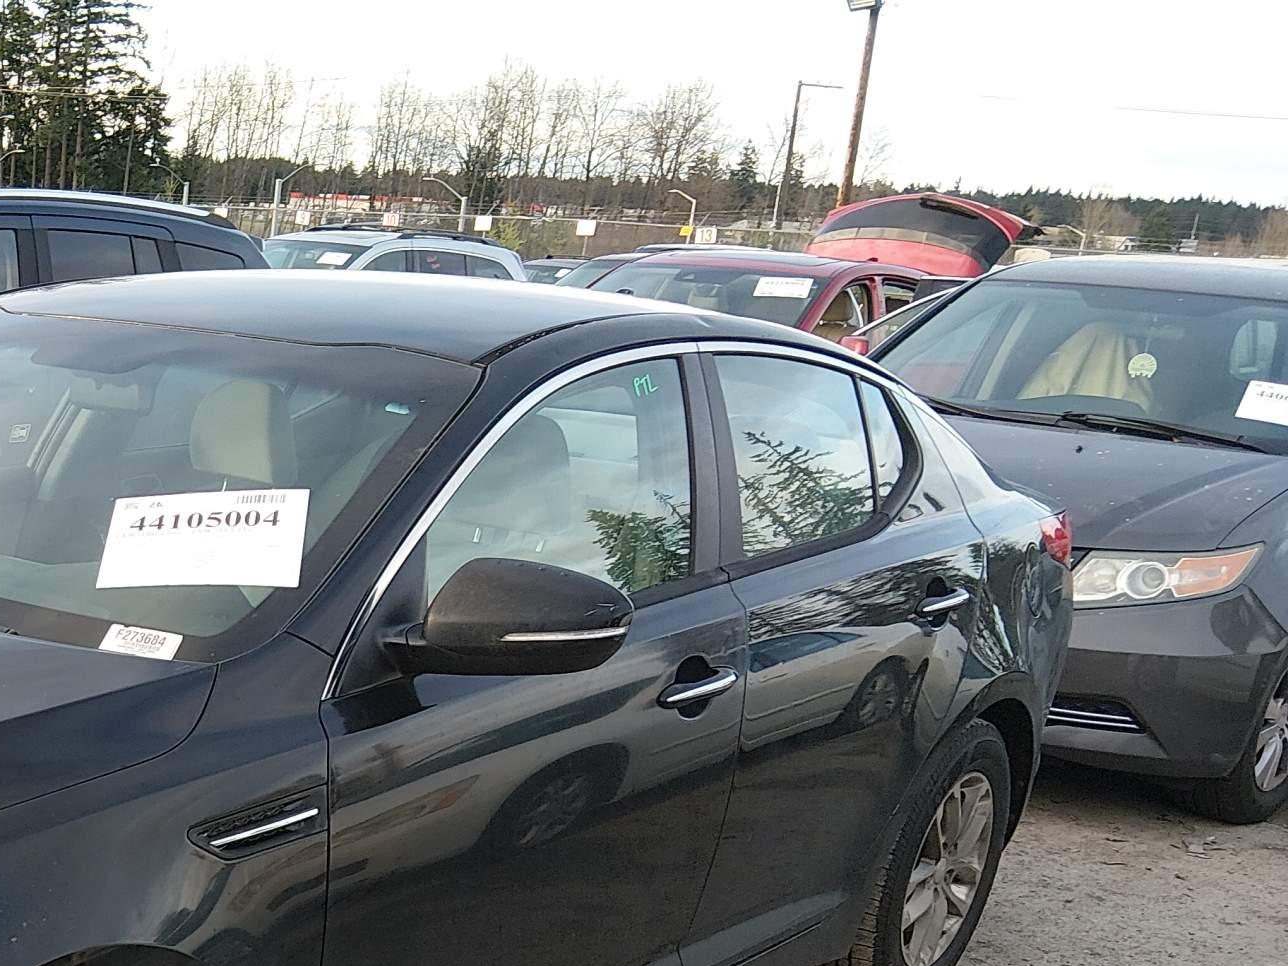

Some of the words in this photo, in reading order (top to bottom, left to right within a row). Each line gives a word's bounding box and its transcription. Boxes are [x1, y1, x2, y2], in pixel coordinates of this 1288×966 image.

[700, 229, 713, 242] 13
[129, 509, 280, 531] 44105004
[115, 628, 167, 647] F273684
